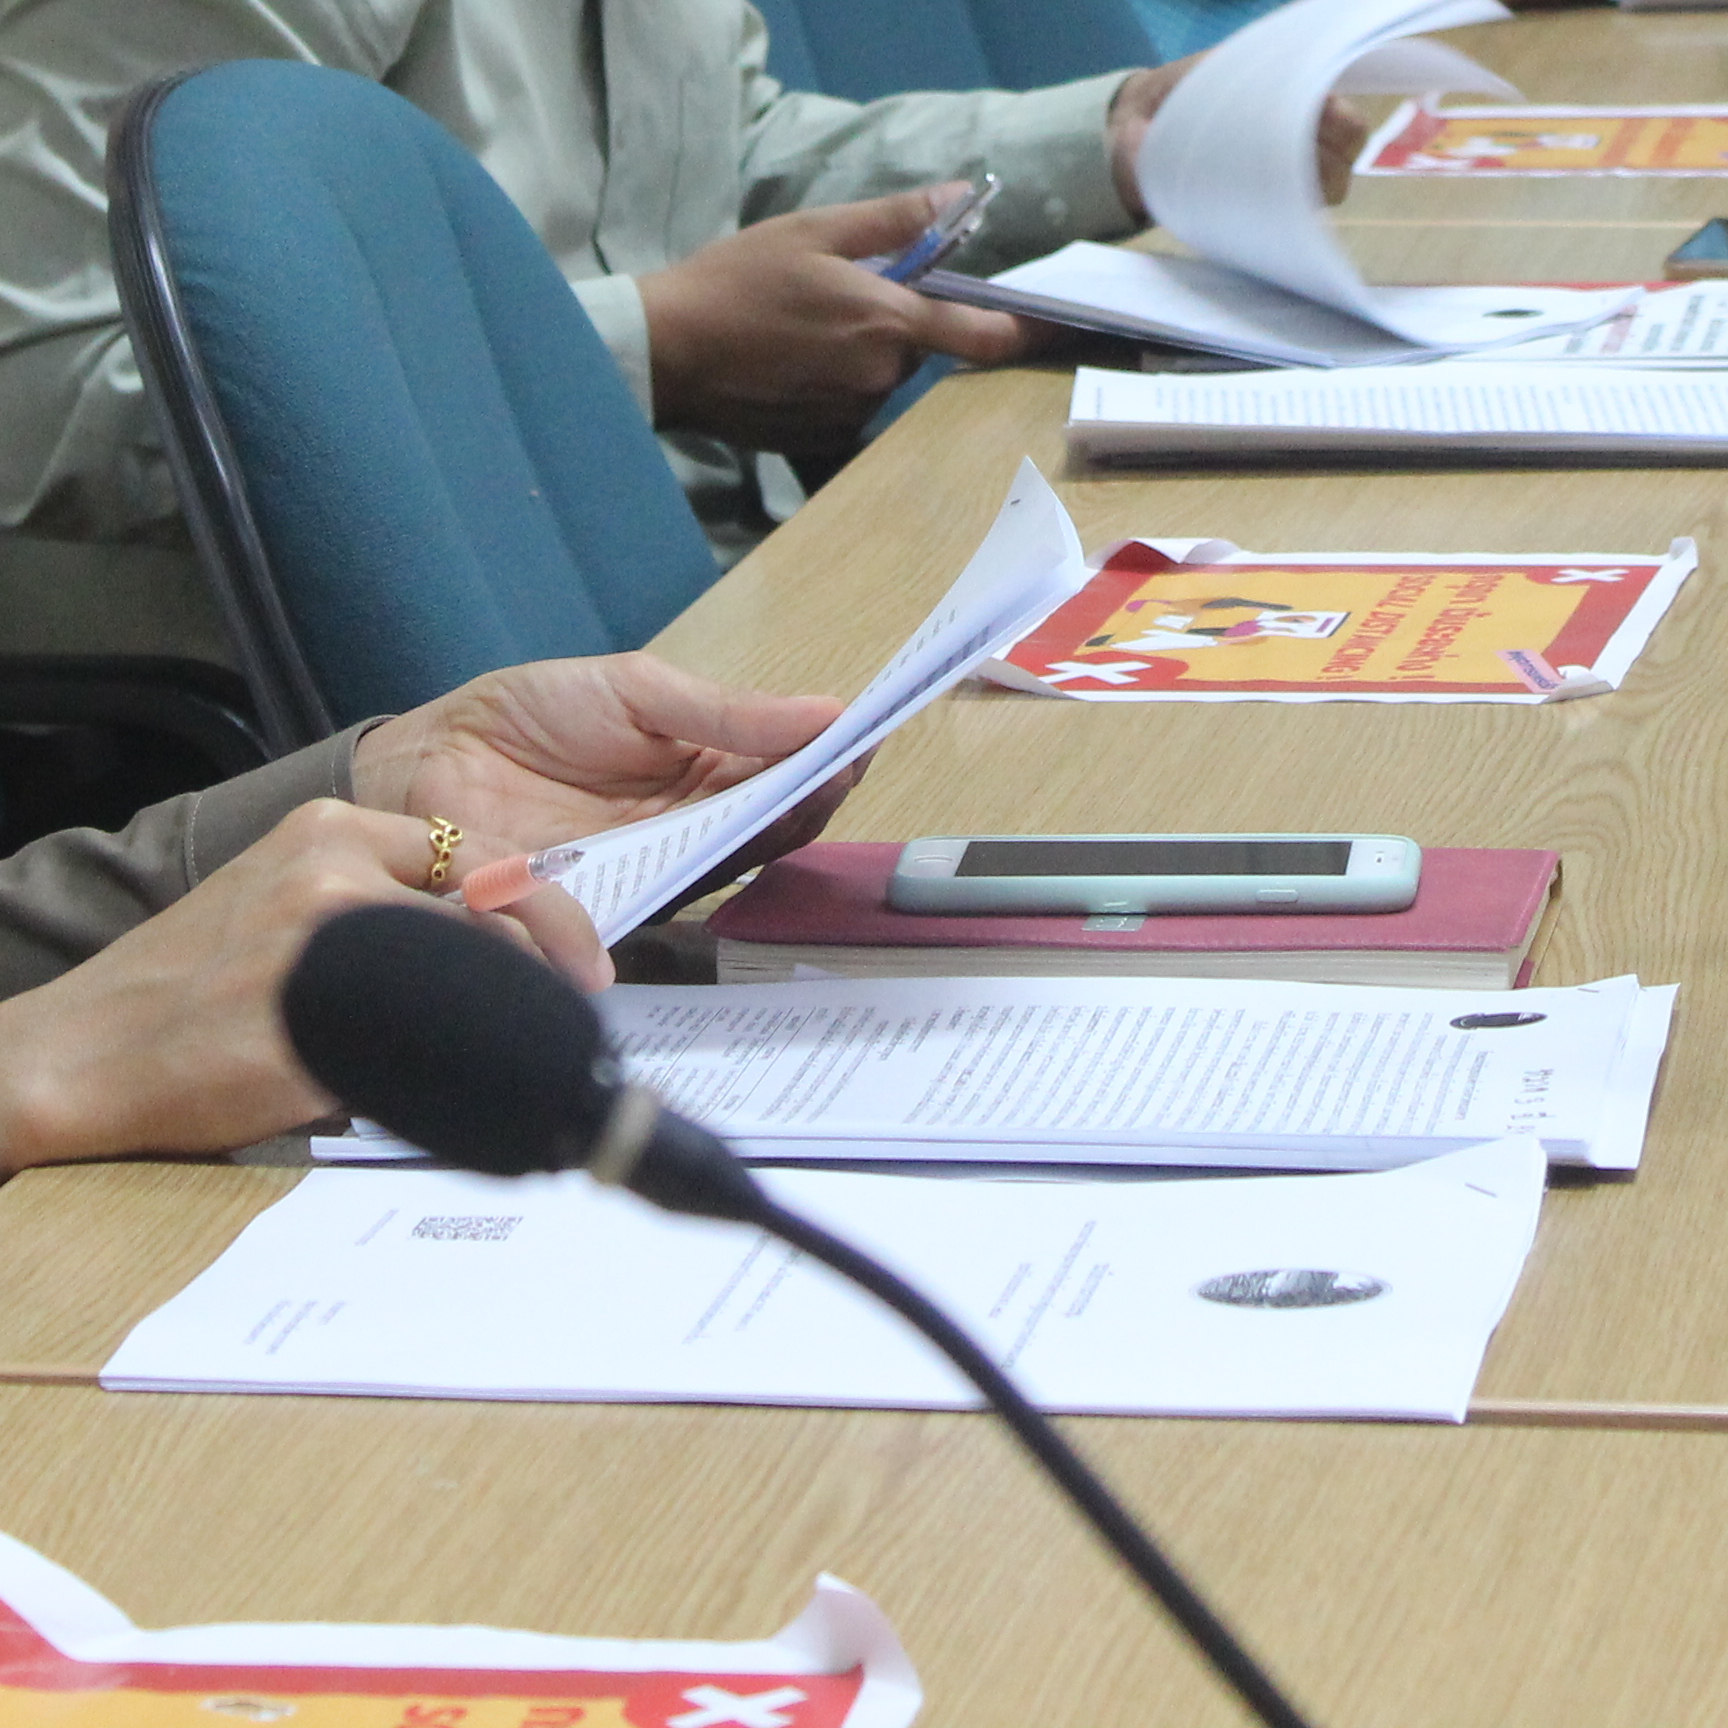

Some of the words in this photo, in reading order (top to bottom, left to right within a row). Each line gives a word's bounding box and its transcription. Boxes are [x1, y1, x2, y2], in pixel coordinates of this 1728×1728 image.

[1375, 574, 1437, 609] SOCIAL
[1396, 607, 1493, 672] เว้นระยะห่าง
